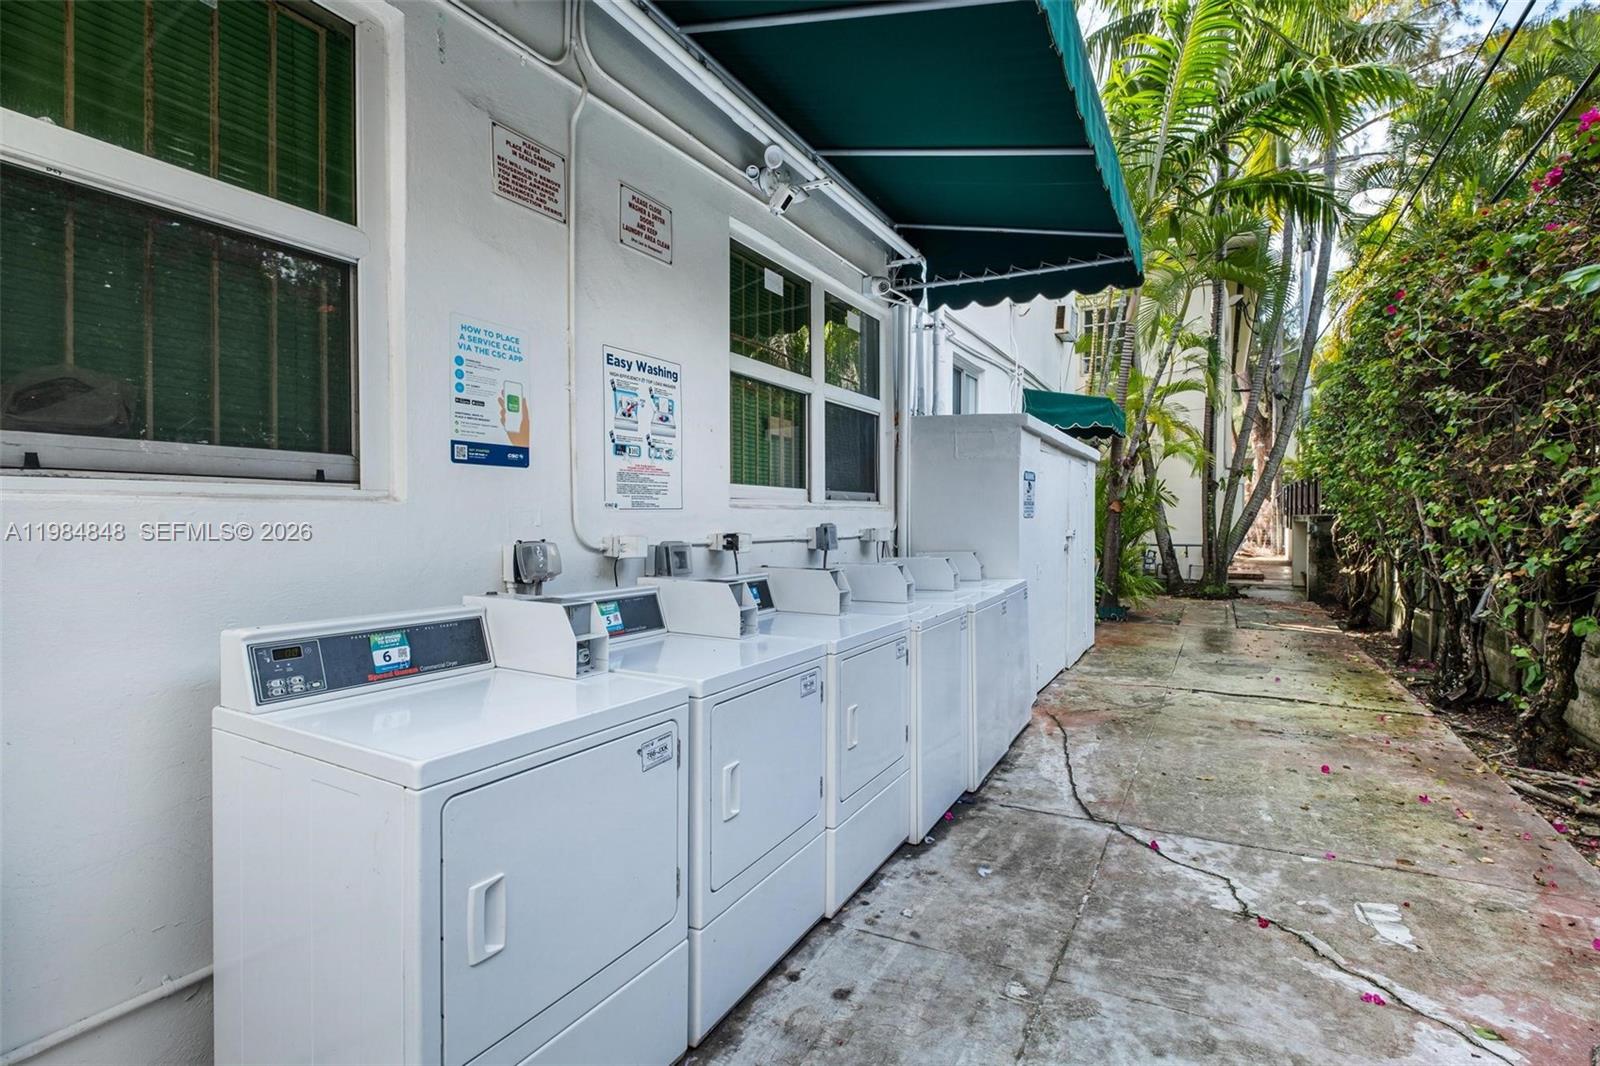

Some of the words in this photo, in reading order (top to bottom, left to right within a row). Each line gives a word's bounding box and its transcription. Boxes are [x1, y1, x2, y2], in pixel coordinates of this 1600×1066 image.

[506, 140, 522, 152] PLACE
[524, 149, 532, 157] ALL
[534, 154, 556, 168] GARBAGE
[522, 141, 540, 154] PLEASE
[509, 160, 522, 171] WILL
[524, 168, 538, 177] ONLY
[540, 174, 561, 188] REMOVE
[518, 153, 538, 166] SEALED
[538, 163, 551, 173] BAGS
[497, 162, 532, 180] HOUSEHOLD
[534, 178, 559, 193] GARBAGE
[498, 168, 510, 176] YOU
[512, 174, 528, 184] MUST
[528, 182, 555, 197] ARRANGE
[498, 174, 510, 182] FOR
[511, 180, 538, 196] REMOVAL
[548, 196, 558, 204] OLD
[498, 180, 534, 199] APPLIANCES
[536, 196, 547, 205] AND
[498, 186, 542, 208] CONSTRUCTION
[544, 206, 562, 217] DEBRIS
[628, 201, 646, 215] WASHER
[652, 213, 665, 225] DRYER
[632, 194, 648, 208] PLEASE
[648, 204, 662, 216] CLOSE
[637, 222, 646, 231] AND
[646, 226, 658, 236] KEEP
[640, 215, 655, 227] DOORS
[622, 224, 643, 238] LAUNDRY
[644, 234, 656, 244] AREA
[657, 240, 670, 250] CLEAR
[461, 324, 481, 334] HOW
[484, 329, 494, 338] TO
[496, 333, 520, 344] PLACE
[467, 335, 501, 349] SERVICE
[502, 344, 521, 354] CALL
[458, 342, 472, 352] VIA
[474, 346, 489, 356] THE
[491, 351, 507, 359] CSC
[606, 353, 632, 371] Easy
[636, 360, 678, 382] Washing
[383, 650, 392, 662] 6
